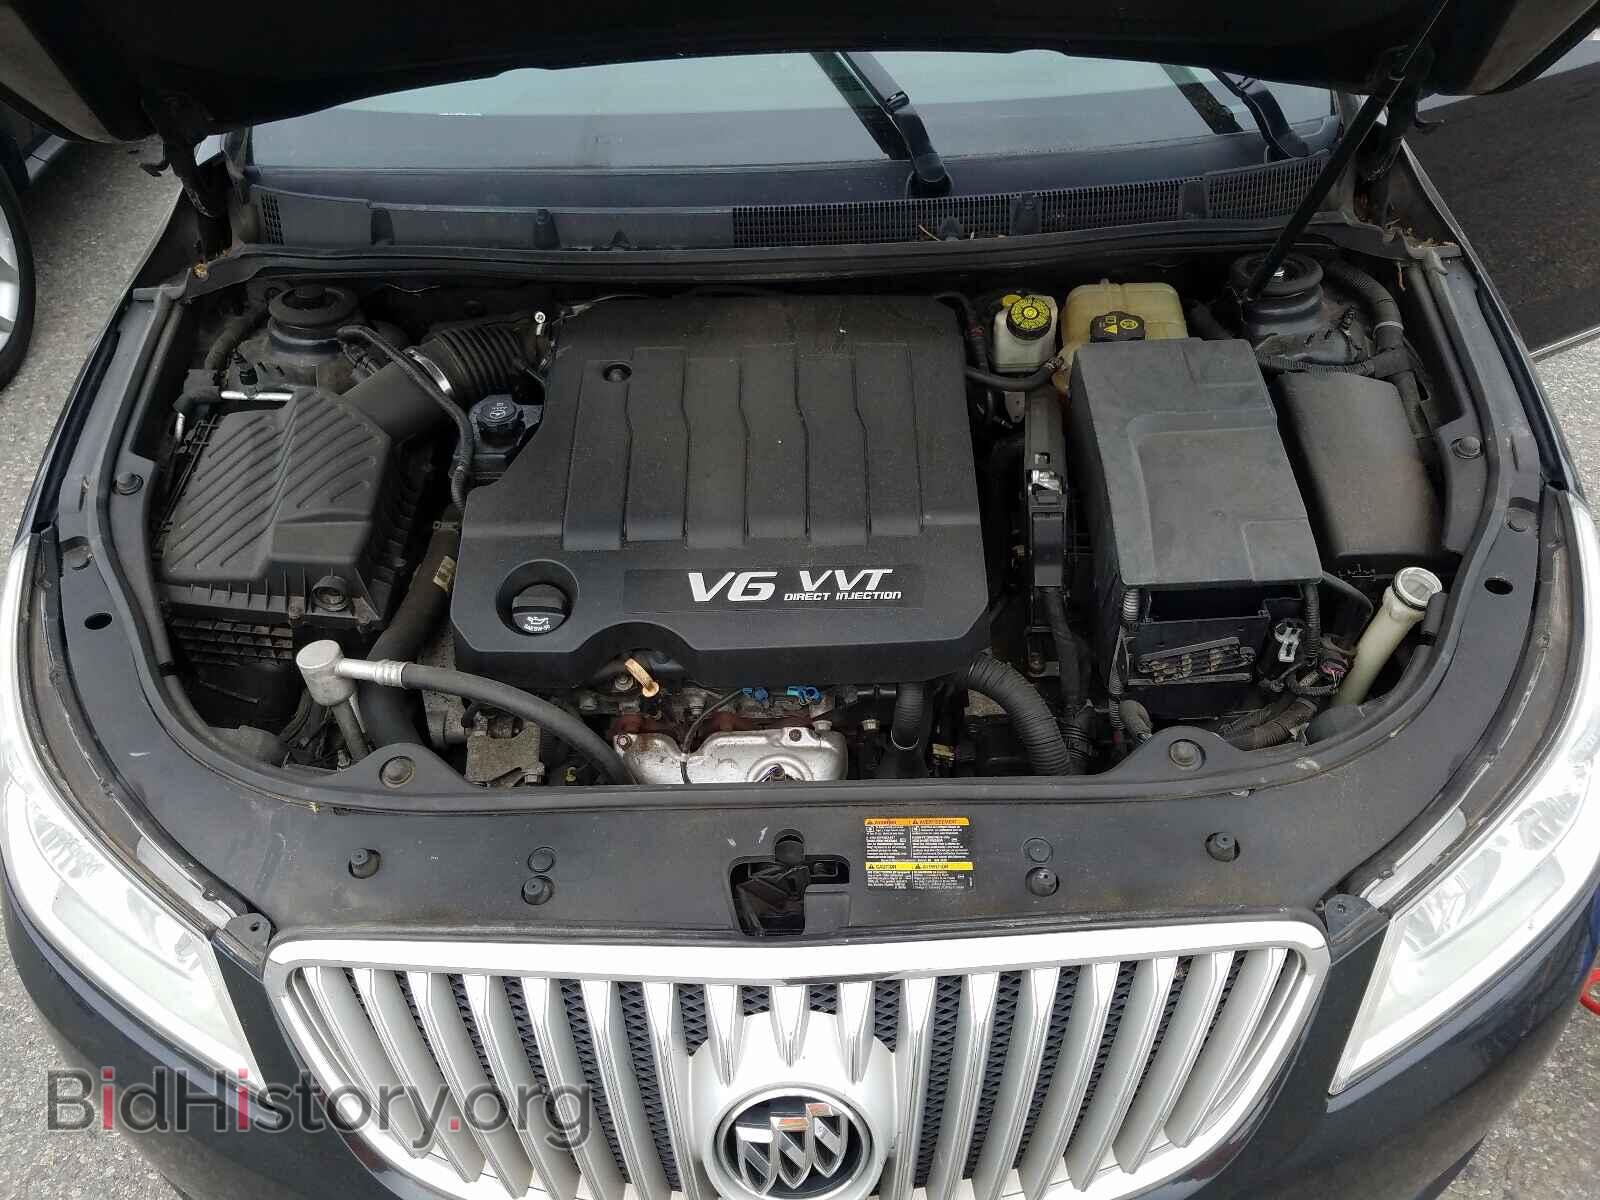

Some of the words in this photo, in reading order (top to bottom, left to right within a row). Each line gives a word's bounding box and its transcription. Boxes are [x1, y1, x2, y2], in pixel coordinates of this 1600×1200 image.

[688, 571, 778, 602] V6
[799, 568, 894, 592] VVT
[783, 592, 831, 601] DIRECT
[835, 591, 902, 600] INJECTION
